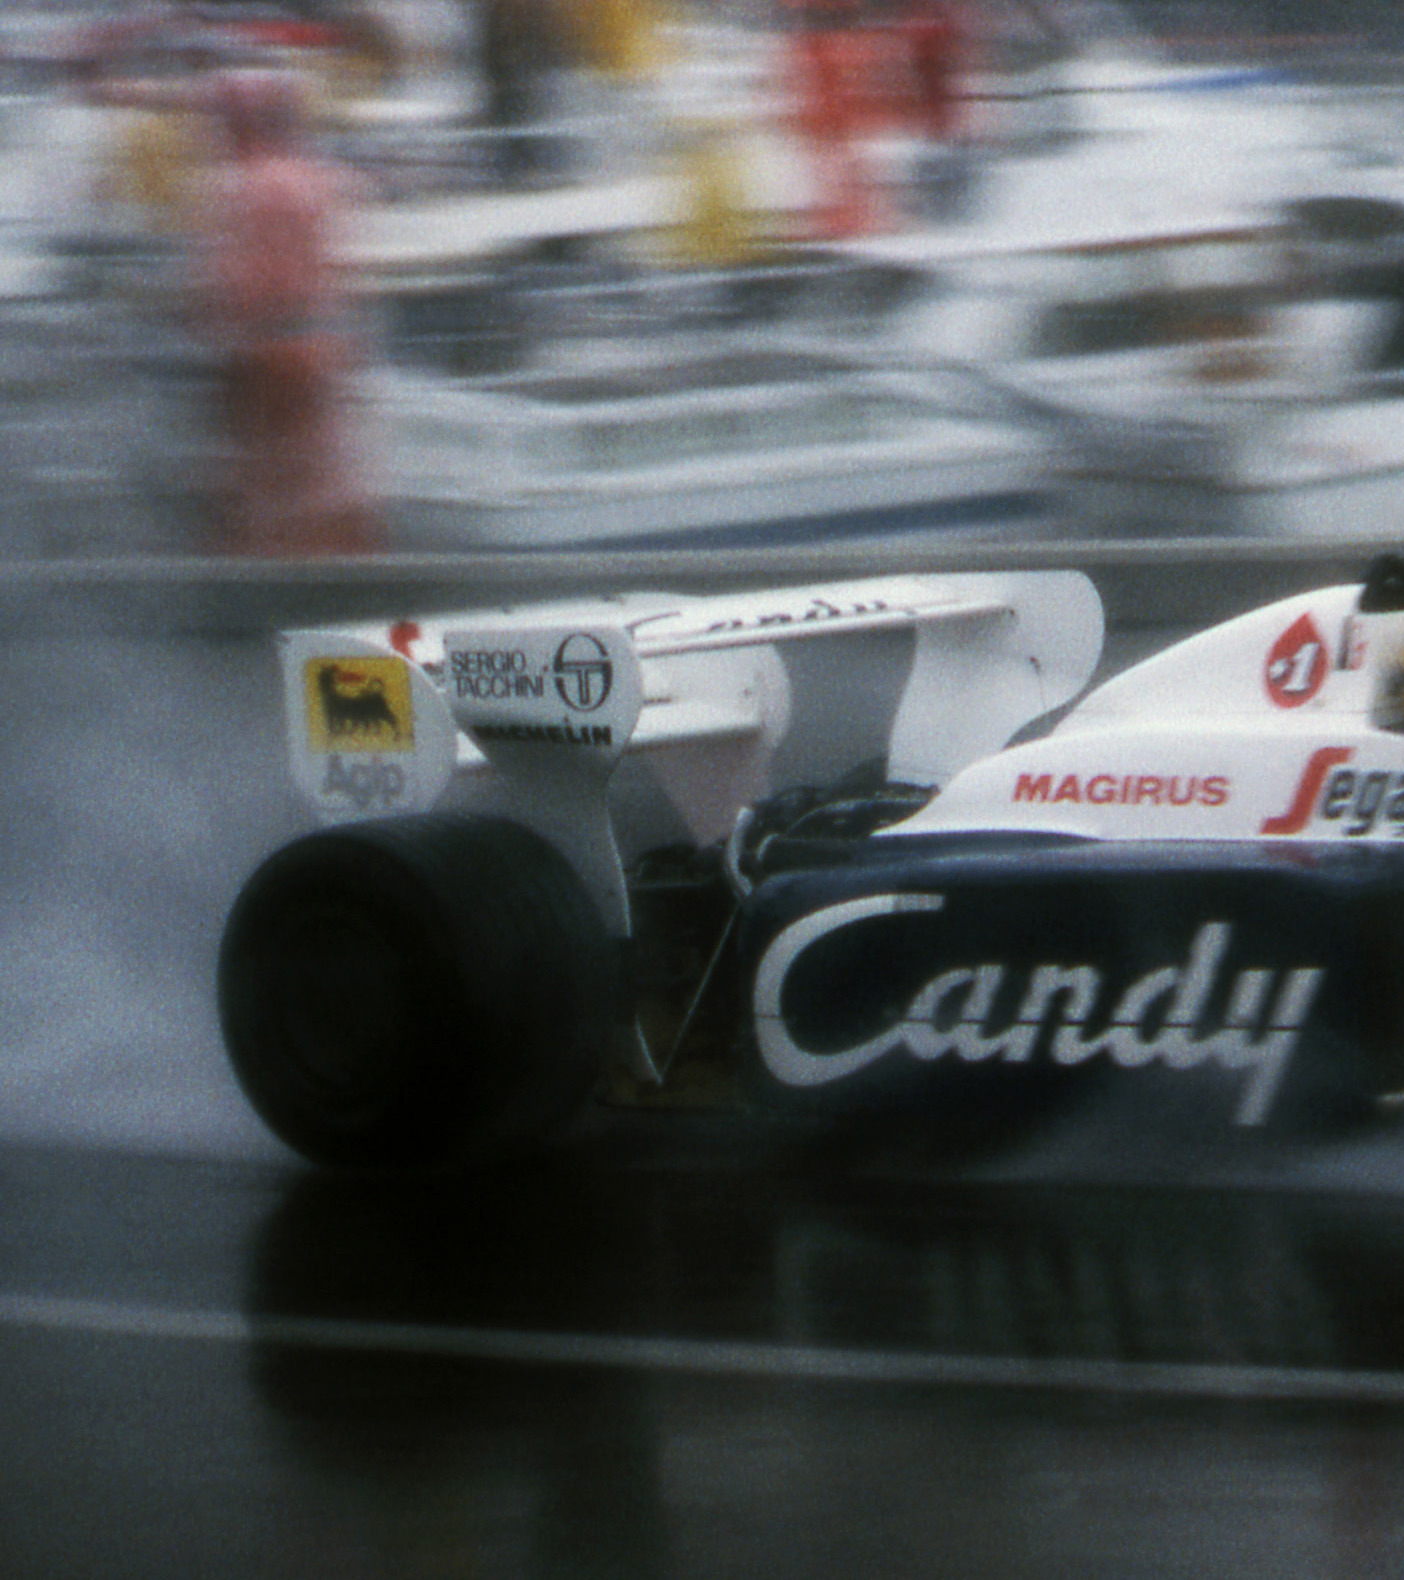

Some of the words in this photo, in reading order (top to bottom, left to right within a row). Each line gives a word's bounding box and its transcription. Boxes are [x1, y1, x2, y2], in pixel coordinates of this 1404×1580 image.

[450, 649, 527, 674] SERGIO
[455, 674, 545, 698] TACCHINI
[1011, 773, 1229, 806] MAGIRUS
[754, 893, 1324, 1125] Candy
